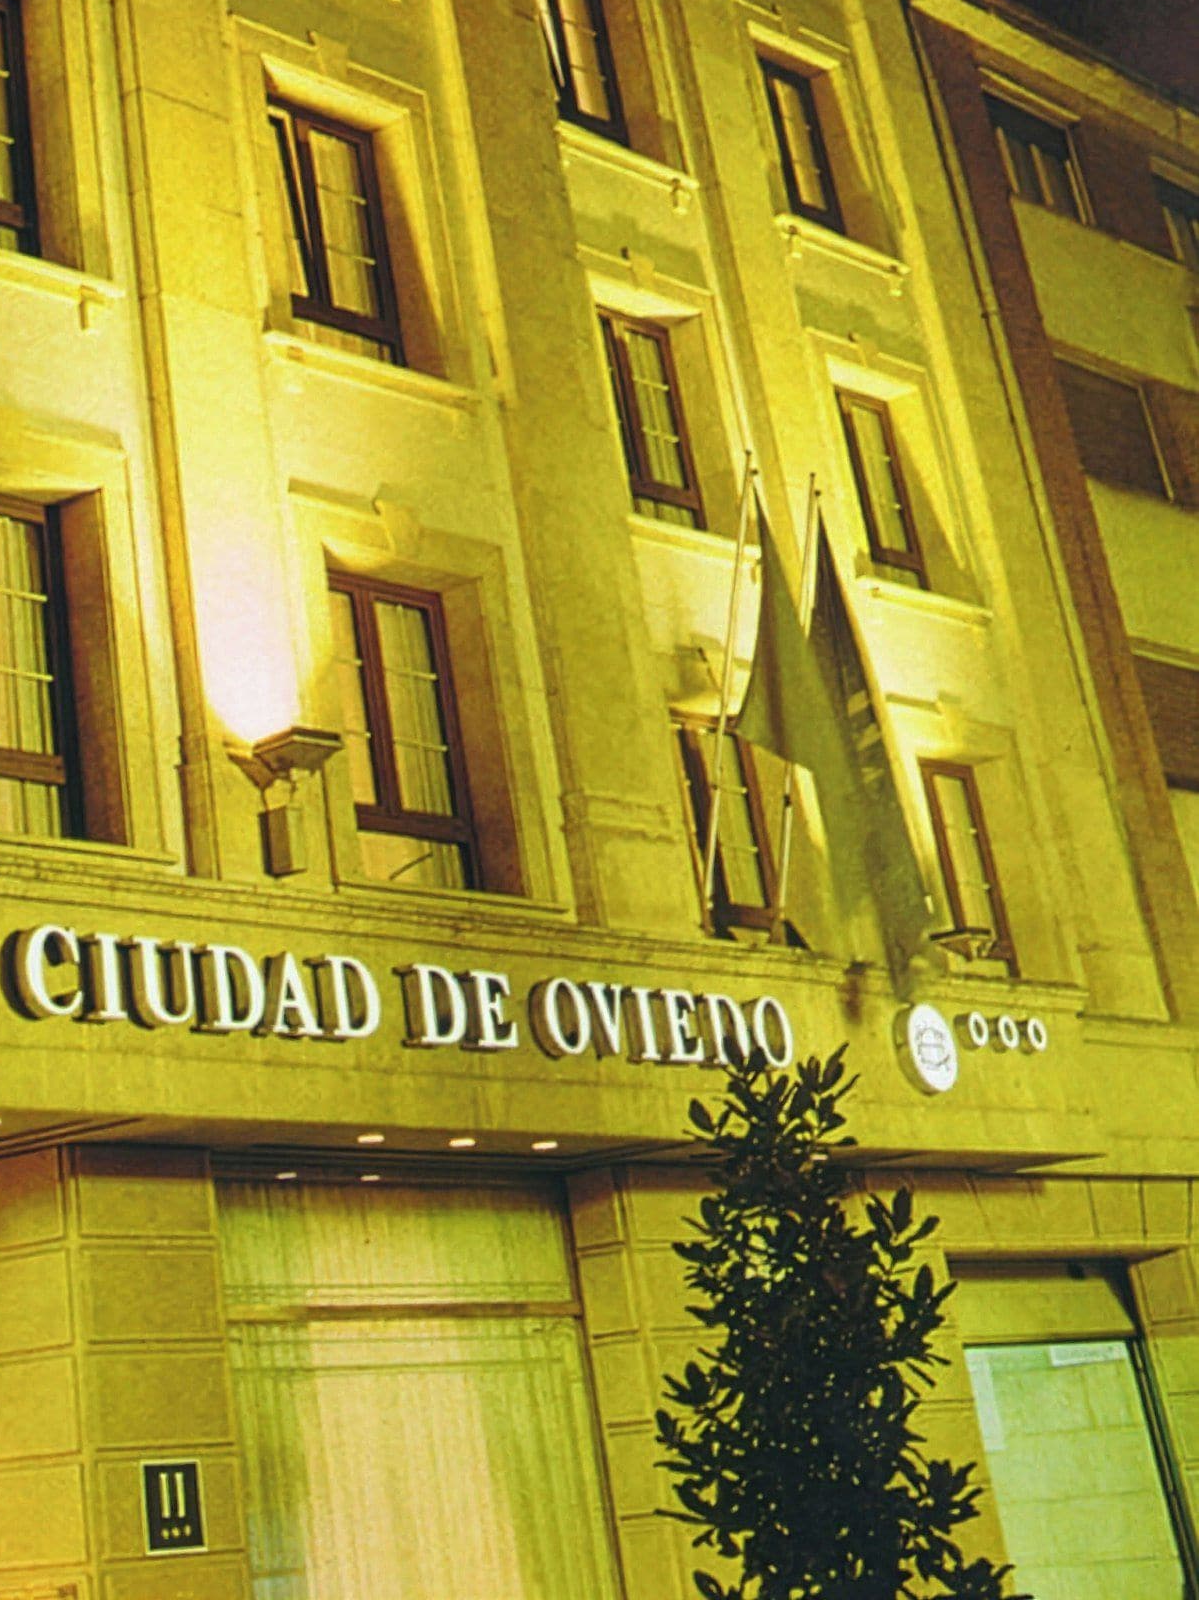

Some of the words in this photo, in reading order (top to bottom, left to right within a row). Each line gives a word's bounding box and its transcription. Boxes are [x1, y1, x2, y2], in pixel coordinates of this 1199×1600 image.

[24, 923, 382, 1038] CIUDAD
[410, 962, 519, 1048] DE
[545, 976, 793, 1068] OVIEDO
